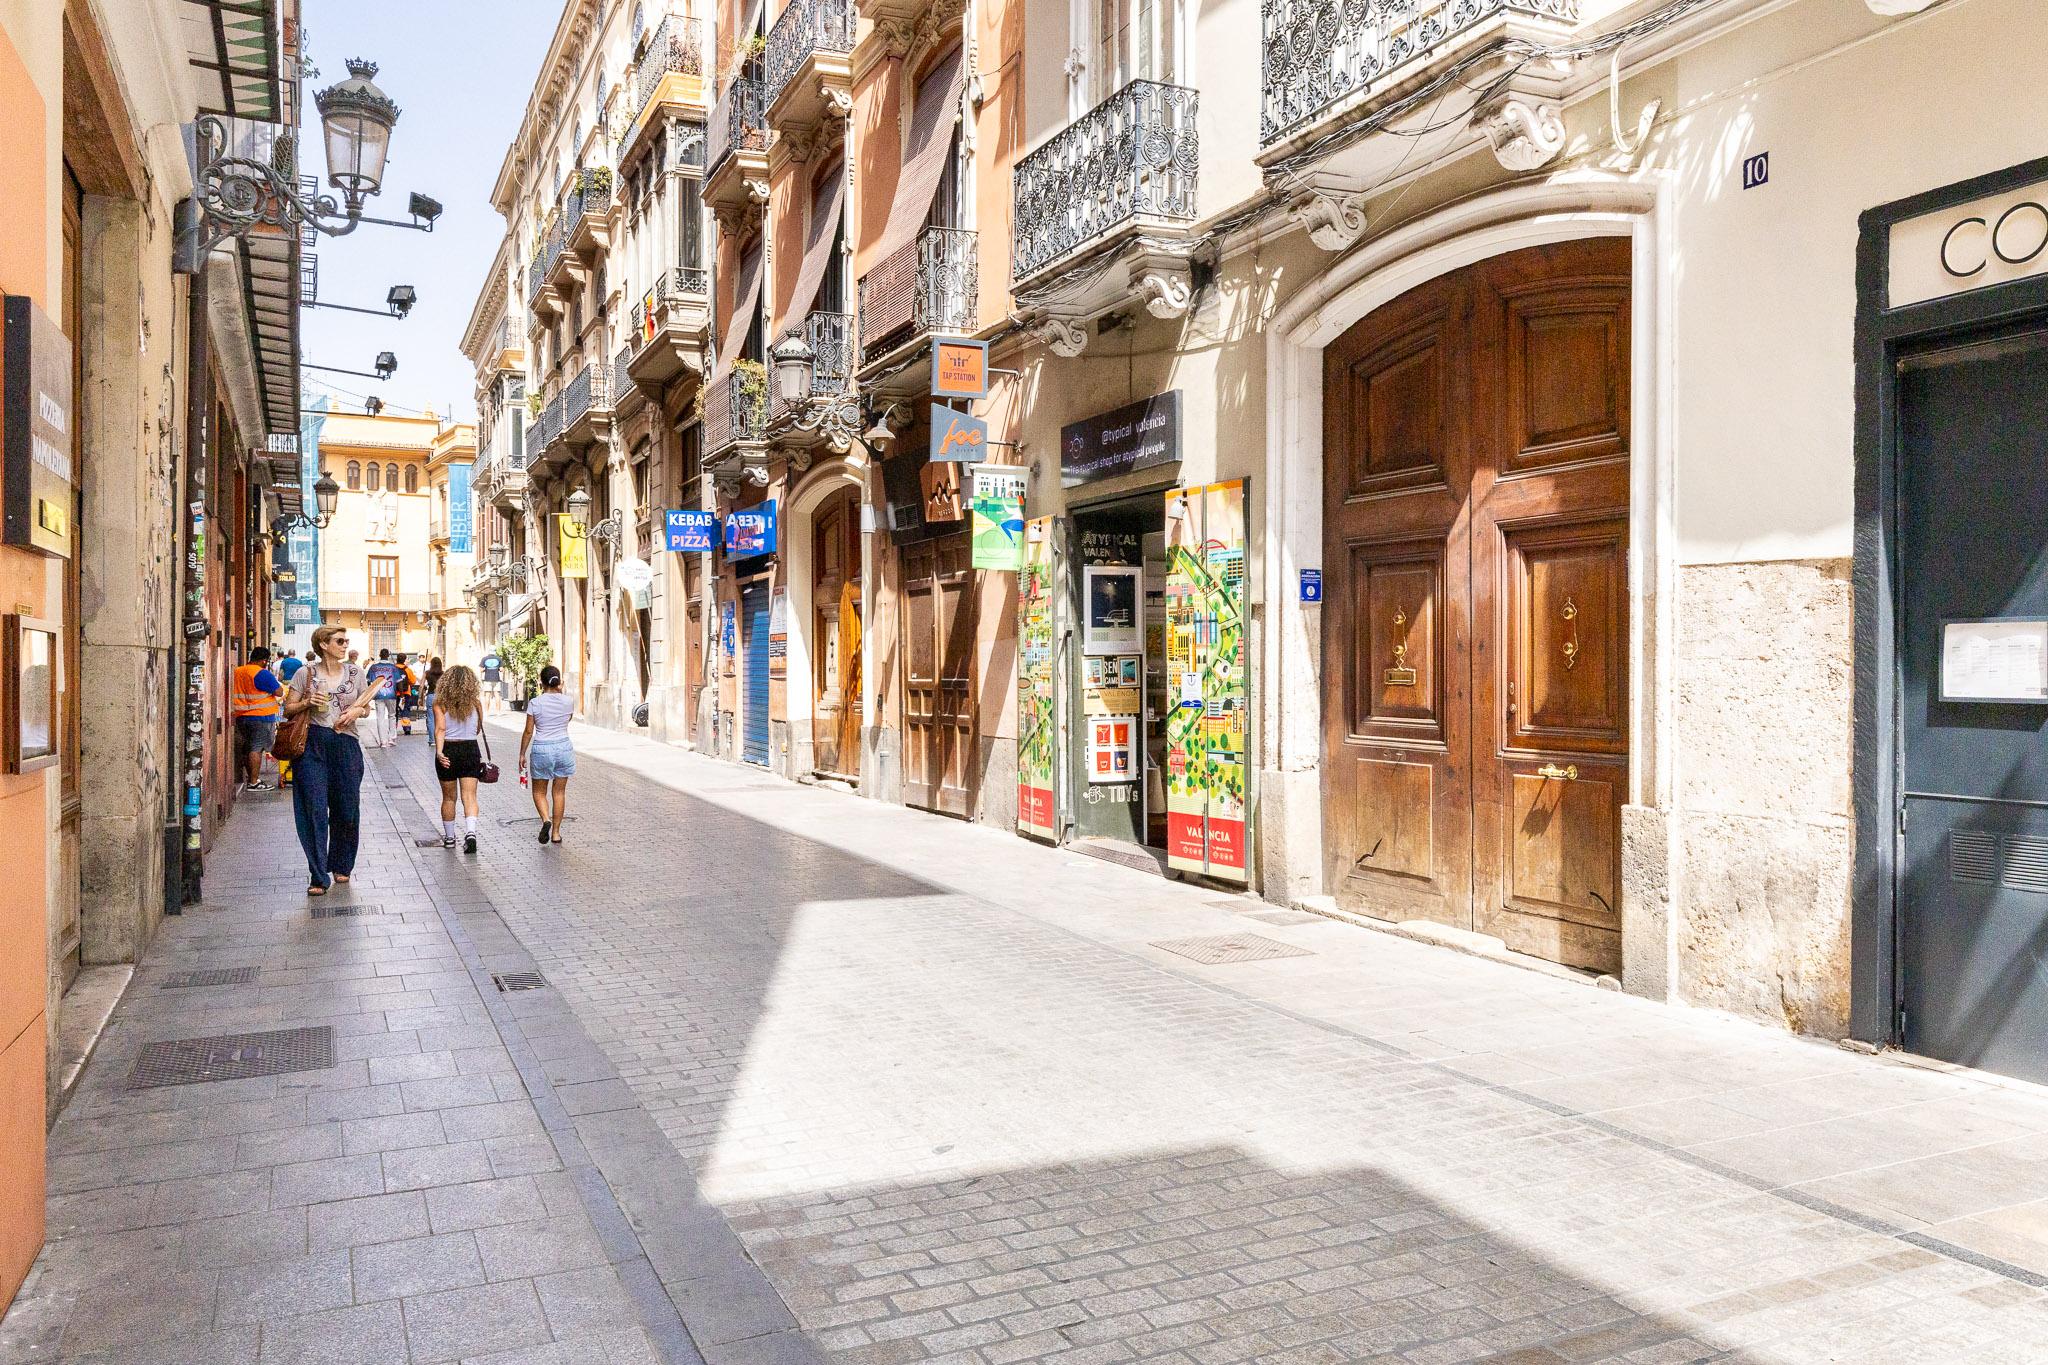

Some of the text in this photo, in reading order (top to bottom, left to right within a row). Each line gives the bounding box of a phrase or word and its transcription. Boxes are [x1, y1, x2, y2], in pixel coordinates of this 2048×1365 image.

[1746, 156, 1767, 187] 10
[1940, 201, 2048, 278] CO
[942, 371, 976, 382] TAP STATION
[1101, 413, 1166, 445] @typical valencia
[1099, 456, 1113, 468] shop
[1113, 453, 1122, 464] for
[1122, 445, 1145, 463] atypical
[1145, 440, 1166, 458] people
[669, 513, 713, 527] KEBAB
[671, 535, 711, 548] PIZZA
[1186, 825, 1231, 843] VALNCIA
